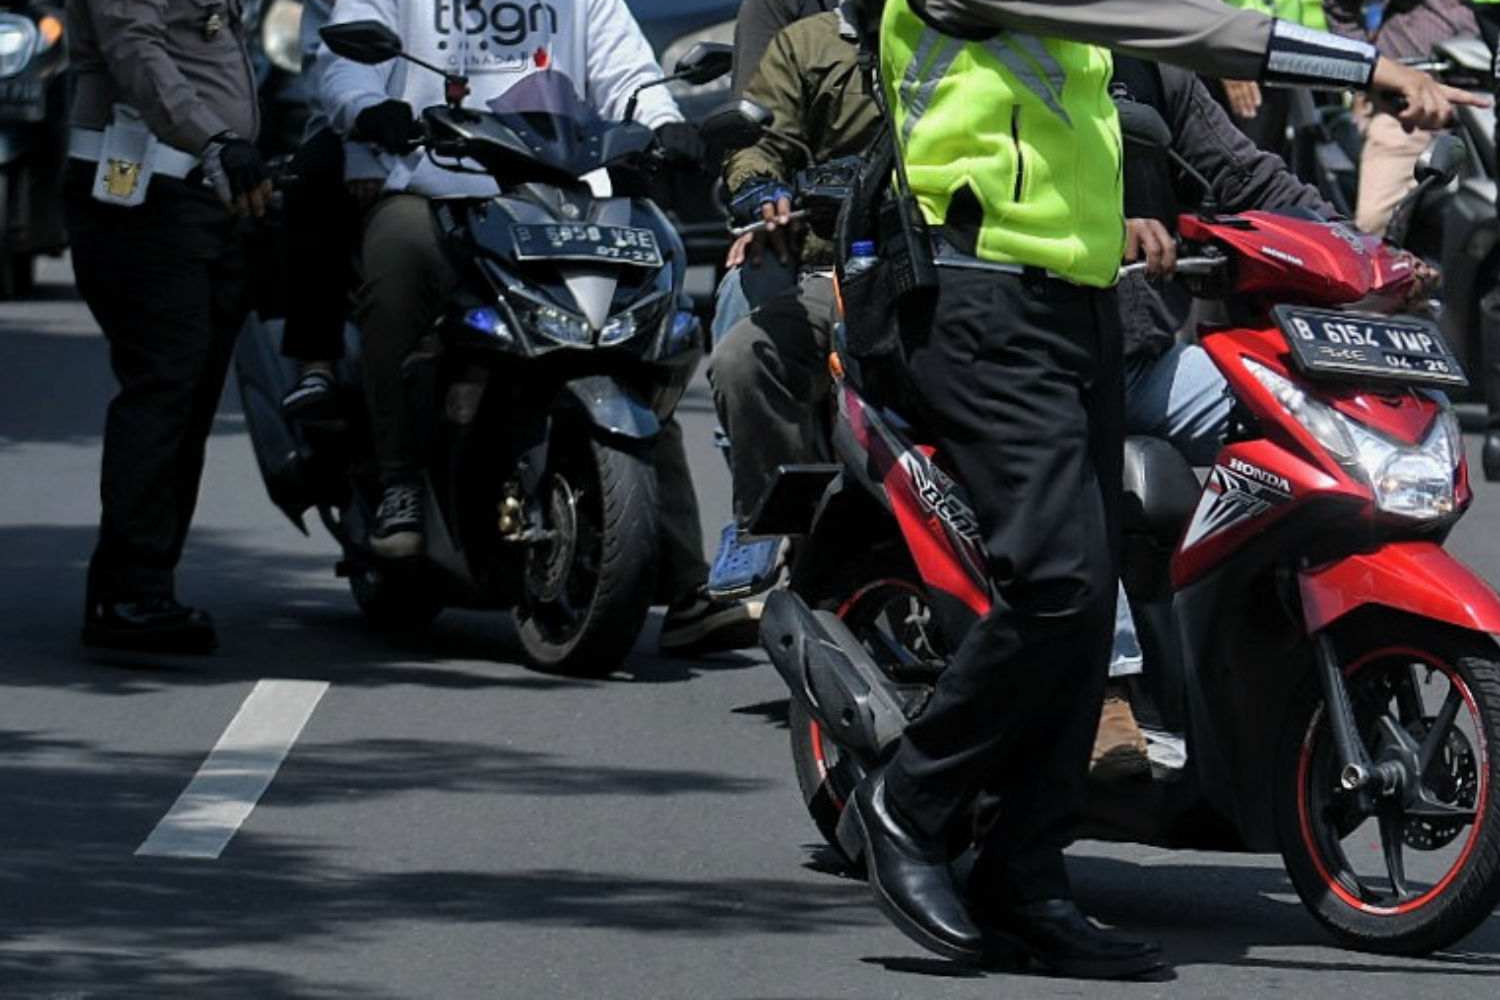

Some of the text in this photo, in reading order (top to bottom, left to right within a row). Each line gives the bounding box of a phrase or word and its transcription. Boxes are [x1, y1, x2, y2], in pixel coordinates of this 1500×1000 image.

[1292, 318, 1434, 353] B 6154 VMP
[1230, 457, 1291, 493] HONDA
